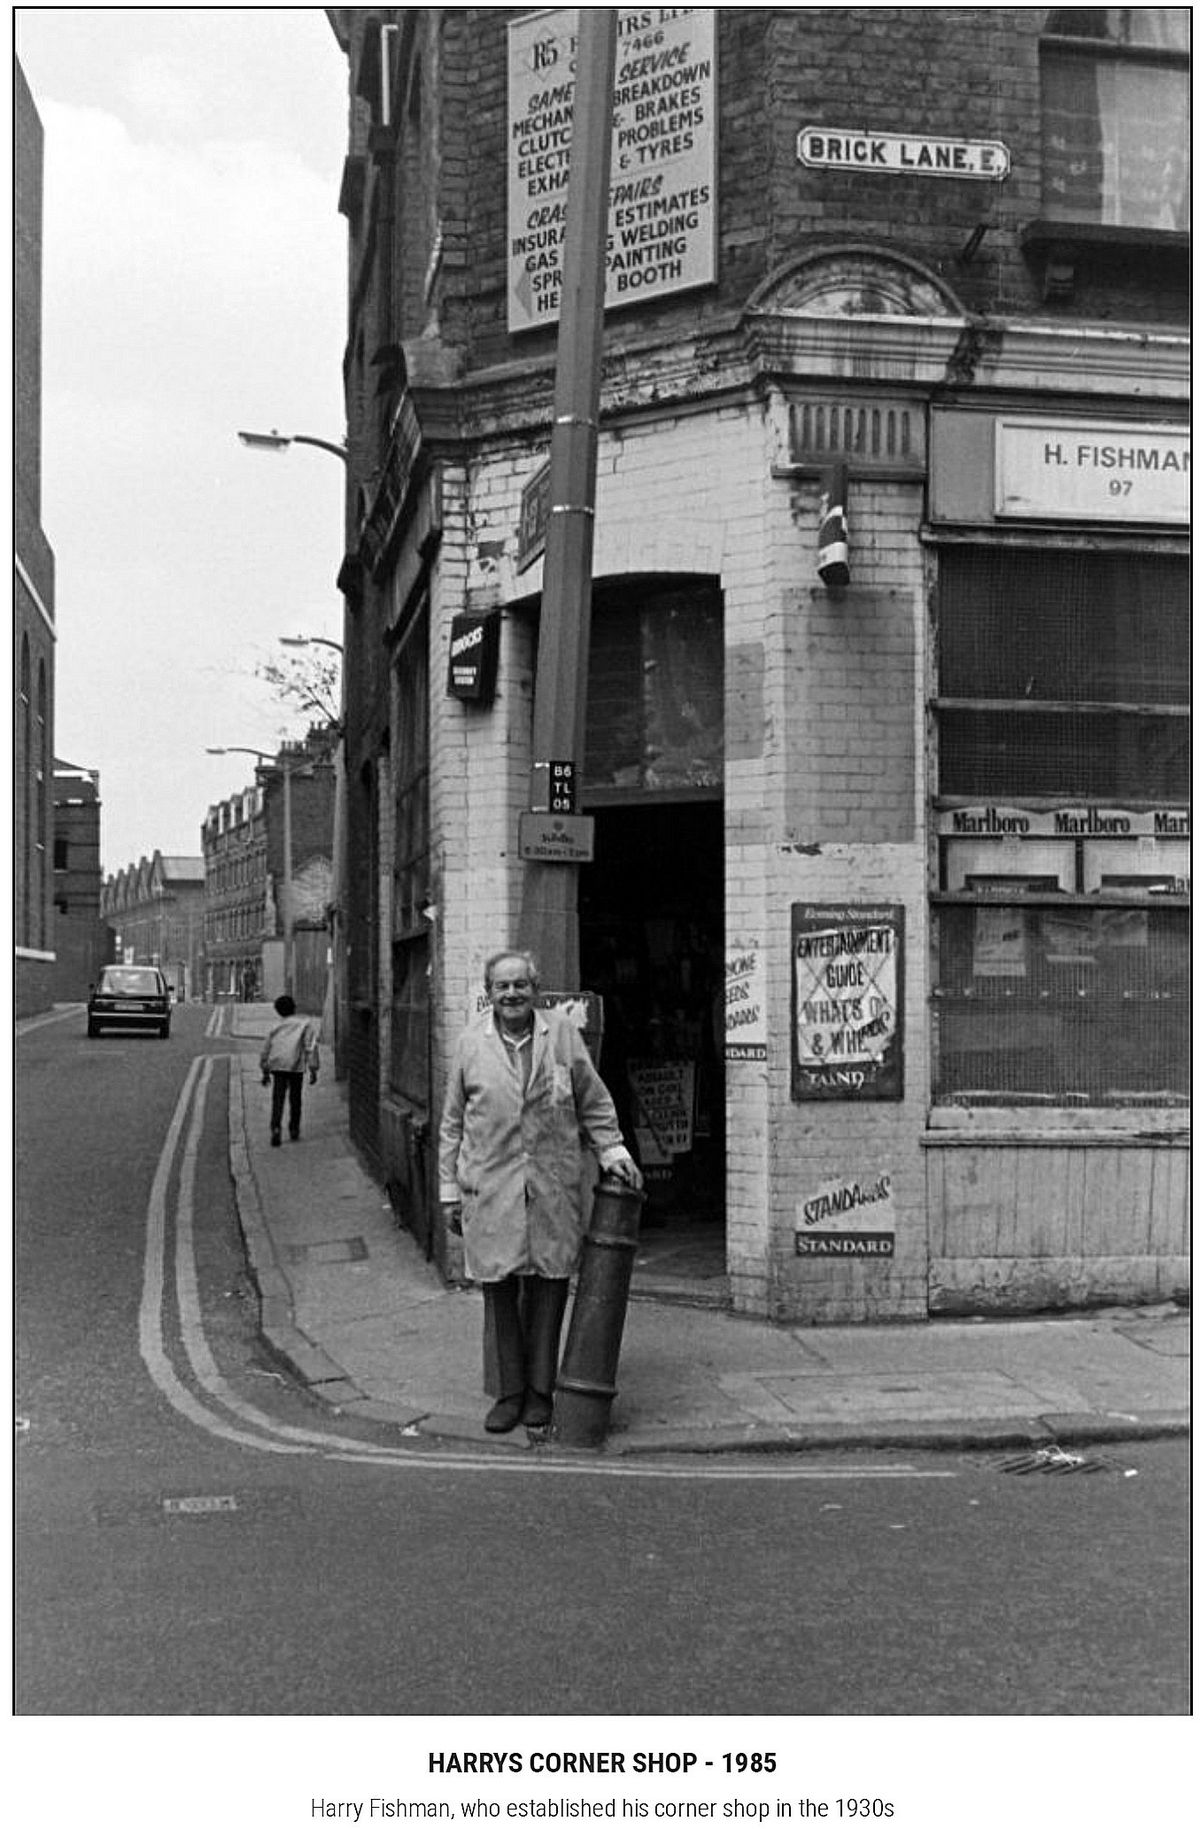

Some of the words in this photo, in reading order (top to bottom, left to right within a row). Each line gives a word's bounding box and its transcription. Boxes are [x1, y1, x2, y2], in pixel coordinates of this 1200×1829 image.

[618, 42, 692, 84] SERVICE
[513, 105, 574, 138] MECHAN
[613, 60, 711, 106] BREAKDOWN
[518, 128, 573, 157] CLUTC
[635, 86, 701, 122] BRAKES
[618, 108, 704, 149] PROBLEMS
[809, 135, 887, 164] BRICK
[528, 170, 570, 197] EXHA
[637, 132, 694, 165] TYRES
[615, 185, 710, 228] ESTIMATES
[525, 250, 558, 273] GAS
[621, 211, 699, 248] WELDING
[532, 270, 563, 293] SPR
[617, 260, 682, 293] BOOTH
[1044, 443, 1068, 465] H.
[1108, 480, 1134, 497] 97
[554, 765, 572, 777] B6
[553, 782, 572, 794] TL
[953, 808, 1030, 833] Marlboro
[1054, 808, 1131, 833] Marlboro
[826, 961, 864, 988] GUIDE
[726, 1049, 766, 1059] DARD
[813, 1033, 824, 1055] &
[797, 1239, 892, 1253] STANDARD
